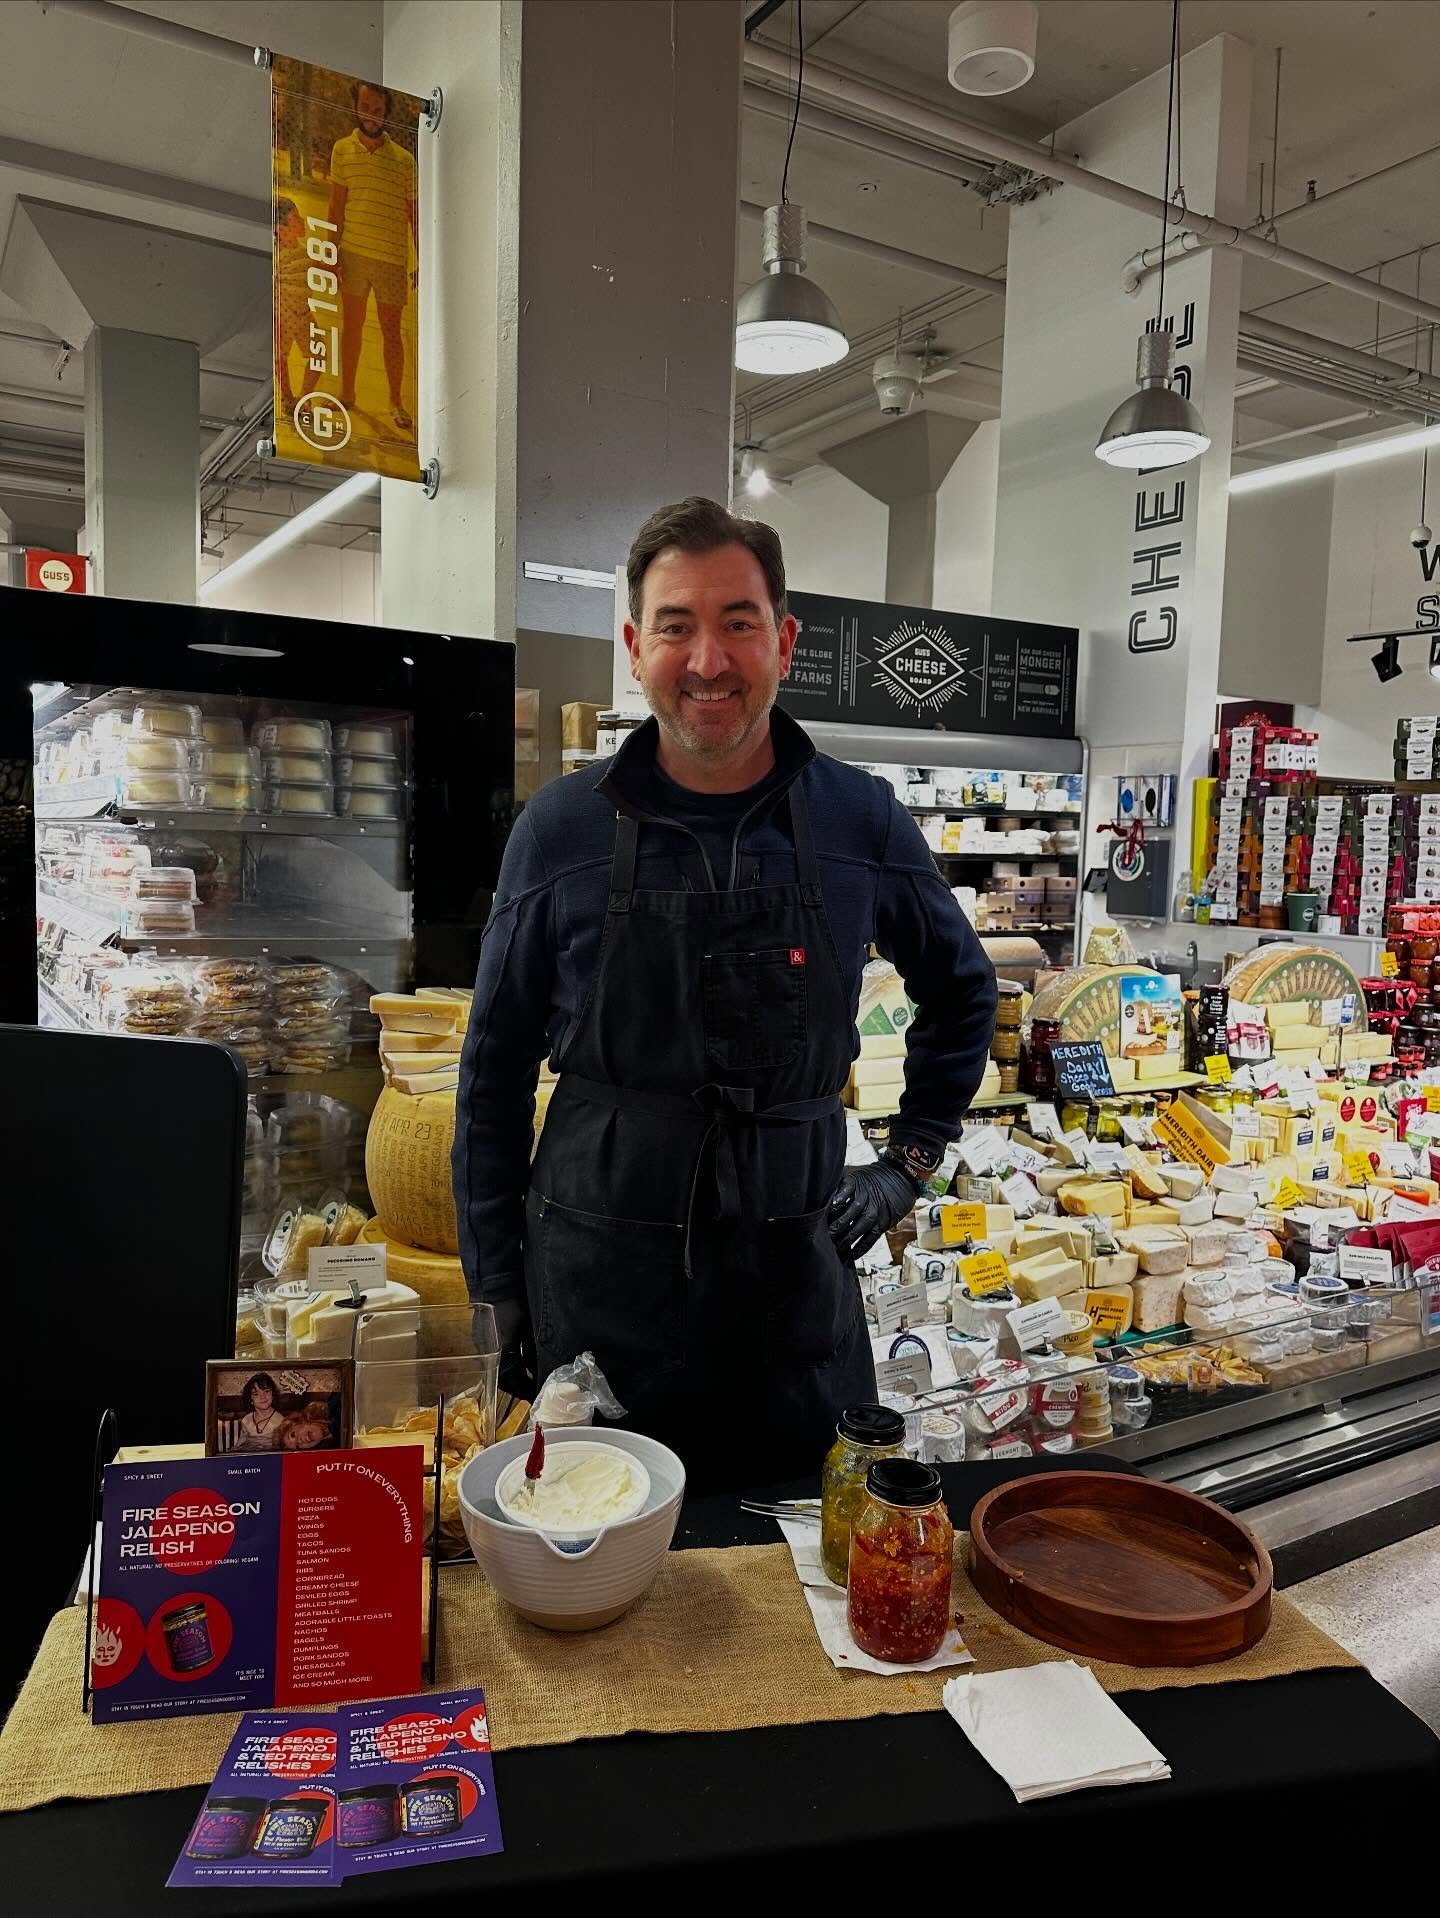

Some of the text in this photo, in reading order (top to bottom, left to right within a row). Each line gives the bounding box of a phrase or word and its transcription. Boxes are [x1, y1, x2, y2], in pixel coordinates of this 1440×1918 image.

[307, 216, 338, 312] 1981
[310, 322, 326, 373] EST
[313, 406, 332, 438] G
[1128, 302, 1195, 654] CHEE
[794, 648, 832, 659] THE GLOBE
[896, 658, 947, 676] CHEESE
[1020, 656, 1060, 670] MONGER
[795, 671, 832, 685] FARMS
[992, 680, 1011, 688] SHEEP
[1052, 1044, 1104, 1060] MEREDITH
[415, 1122, 432, 1140] 23
[1164, 1112, 1198, 1150] MEREDITH
[316, 1462, 413, 1544] PUT IT ON EVERYTHING
[122, 1502, 261, 1522] FIRE SEASON
[121, 1519, 234, 1540] JALAPEÑO
[120, 1541, 194, 1558] RELISH
[296, 1574, 345, 1582] CORNBREAD
[296, 1580, 360, 1591] CREAMY CHEESE
[296, 1592, 326, 1600] DEVILED
[294, 1608, 340, 1618] MEATBALLS
[294, 1612, 392, 1626] ADORABLE LITTLE TOASTS
[294, 1628, 328, 1636] NACHOS
[294, 1636, 324, 1644] BAGELS
[294, 1644, 339, 1654] DUMPLINGS
[316, 1652, 350, 1660] SANDOS
[293, 1660, 346, 1672] QUESADILLAS
[324, 1678, 347, 1686] MUCH
[350, 1717, 453, 1736] FIRE SEASON
[350, 1731, 467, 1753] & RED FRESNO
[238, 1752, 250, 1760] &
[252, 1752, 286, 1760] RED
[350, 1745, 428, 1762] RELISHES
[234, 1762, 312, 1770] RELISHES
[458, 1766, 486, 1796] EVERYTHING
[424, 1794, 454, 1810] SEASON
[288, 1816, 314, 1836] SEASON
